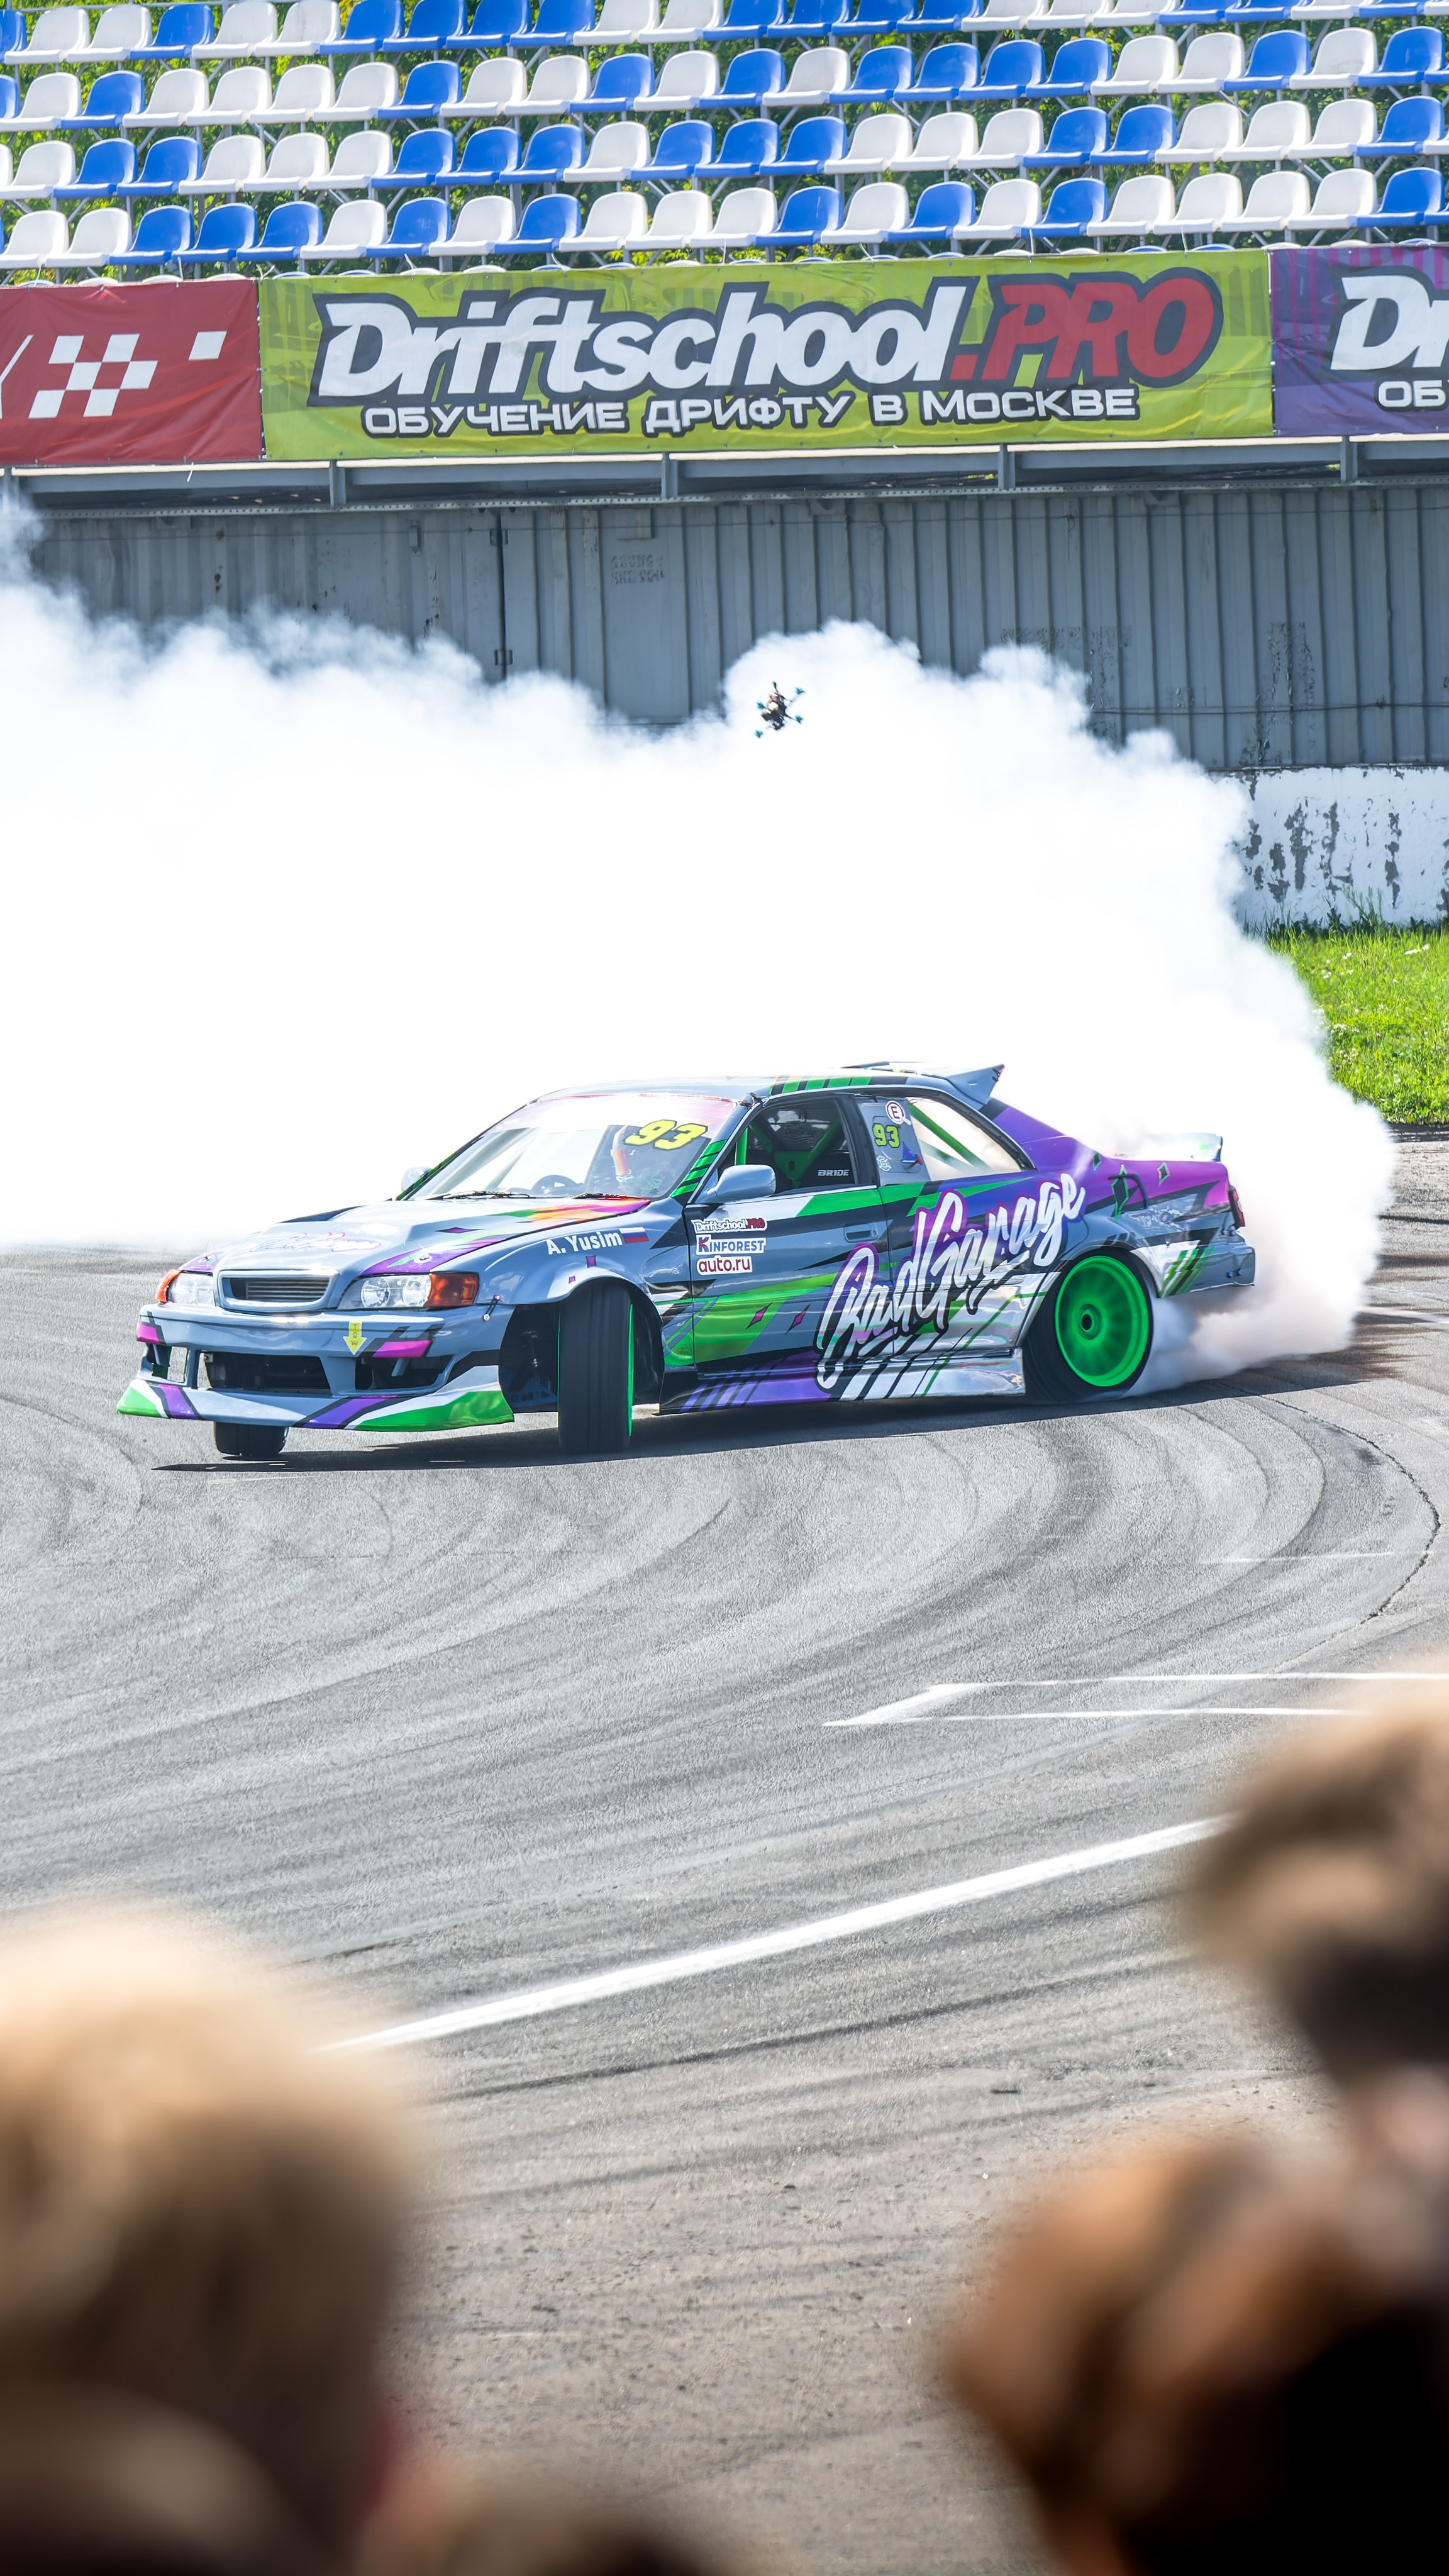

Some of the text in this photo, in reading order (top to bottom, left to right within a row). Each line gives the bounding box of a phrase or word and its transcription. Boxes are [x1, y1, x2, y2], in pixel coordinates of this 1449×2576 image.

[319, 277, 1214, 397] Driftschool.PRO
[1379, 380, 1449, 407] ОБ
[365, 388, 1136, 434] ОБУЧЕНИЕ ДРИФТУ В МОСКВЕ
[623, 1119, 709, 1152] 93
[872, 1123, 901, 1148] 93
[699, 1258, 751, 1273] auto.ru
